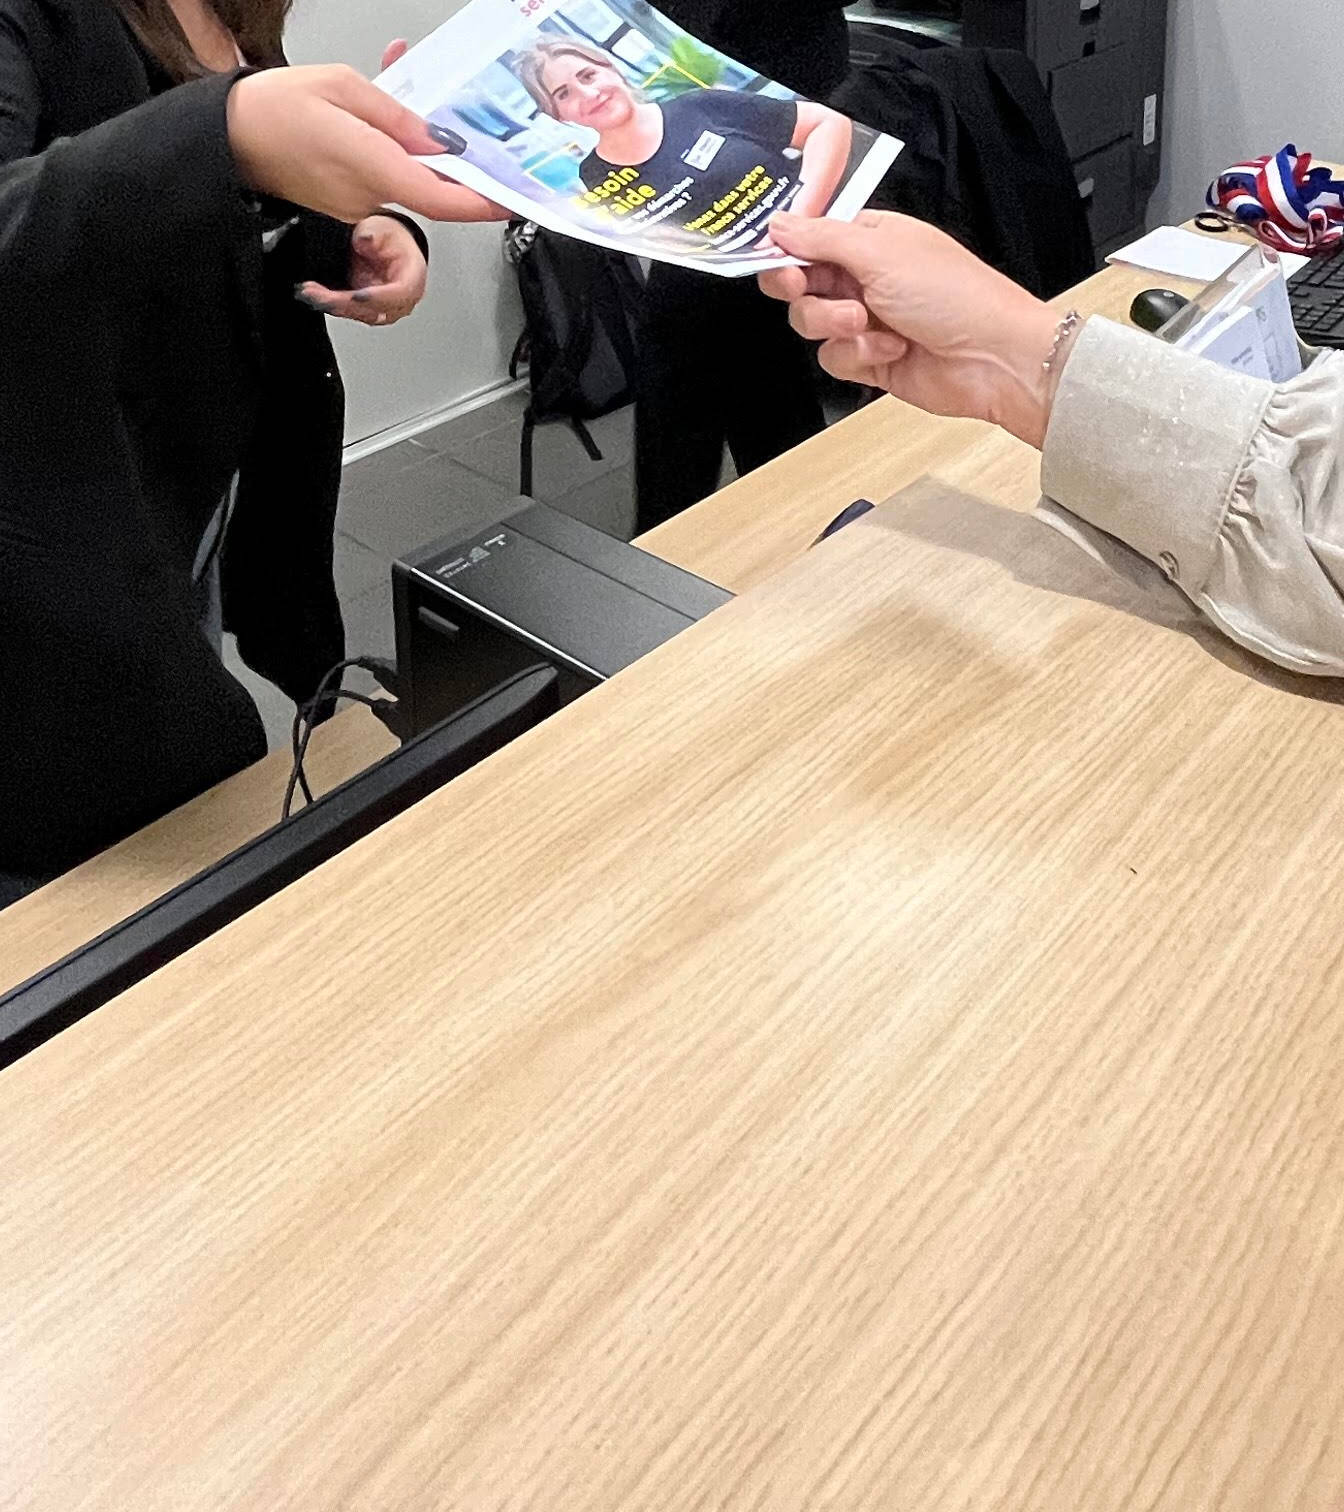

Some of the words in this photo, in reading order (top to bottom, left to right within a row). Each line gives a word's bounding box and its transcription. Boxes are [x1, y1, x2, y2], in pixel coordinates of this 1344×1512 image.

[712, 190, 740, 212] dans
[735, 164, 766, 192] votre
[732, 175, 774, 215] services
